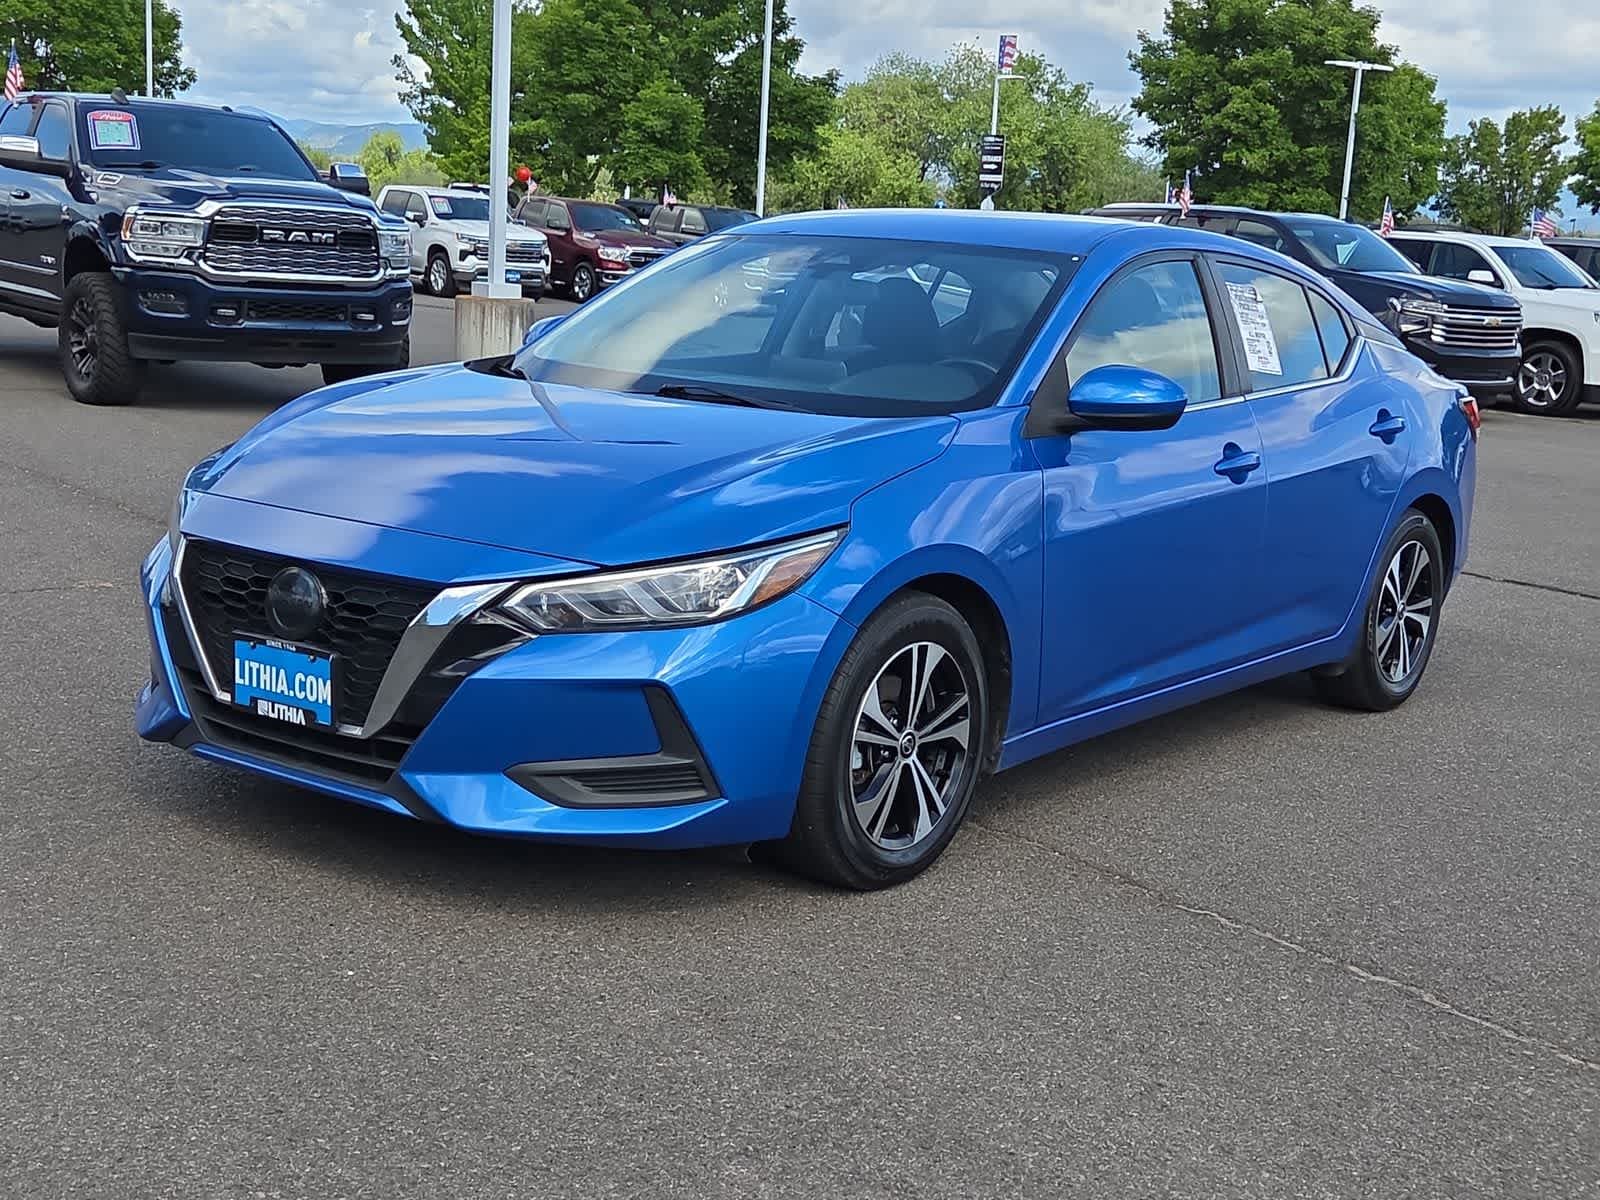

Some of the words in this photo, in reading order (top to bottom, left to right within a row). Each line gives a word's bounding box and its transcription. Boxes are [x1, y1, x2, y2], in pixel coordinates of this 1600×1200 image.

[263, 229, 335, 243] RAM
[235, 658, 331, 706] LITHIA.COM
[268, 700, 306, 726] LITHIA
